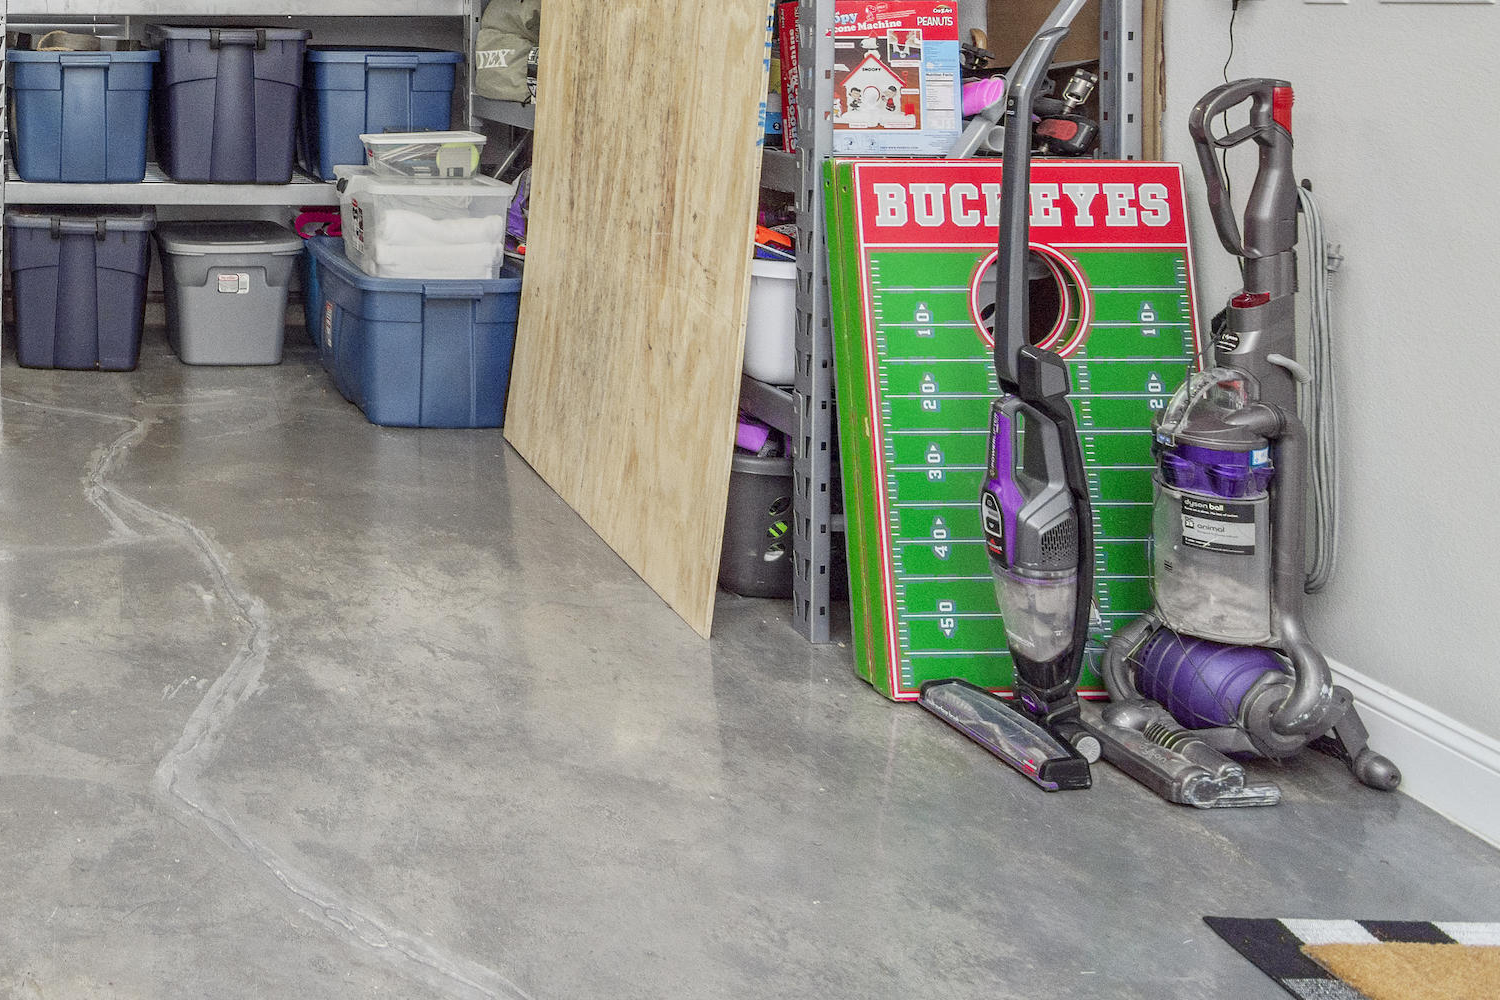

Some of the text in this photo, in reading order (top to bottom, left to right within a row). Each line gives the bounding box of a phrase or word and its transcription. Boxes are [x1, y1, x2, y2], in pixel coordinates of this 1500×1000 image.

[857, 20, 902, 31] Machine
[917, 16, 953, 26] PEANUTS
[476, 48, 509, 69] TEX
[921, 383, 937, 410] 20
[1147, 382, 1164, 409] 20
[927, 453, 942, 480] 30
[1184, 499, 1208, 509] dyson
[1208, 503, 1224, 512] ball
[1197, 524, 1225, 533] animal
[933, 528, 948, 558] 40
[939, 601, 955, 630] 50
